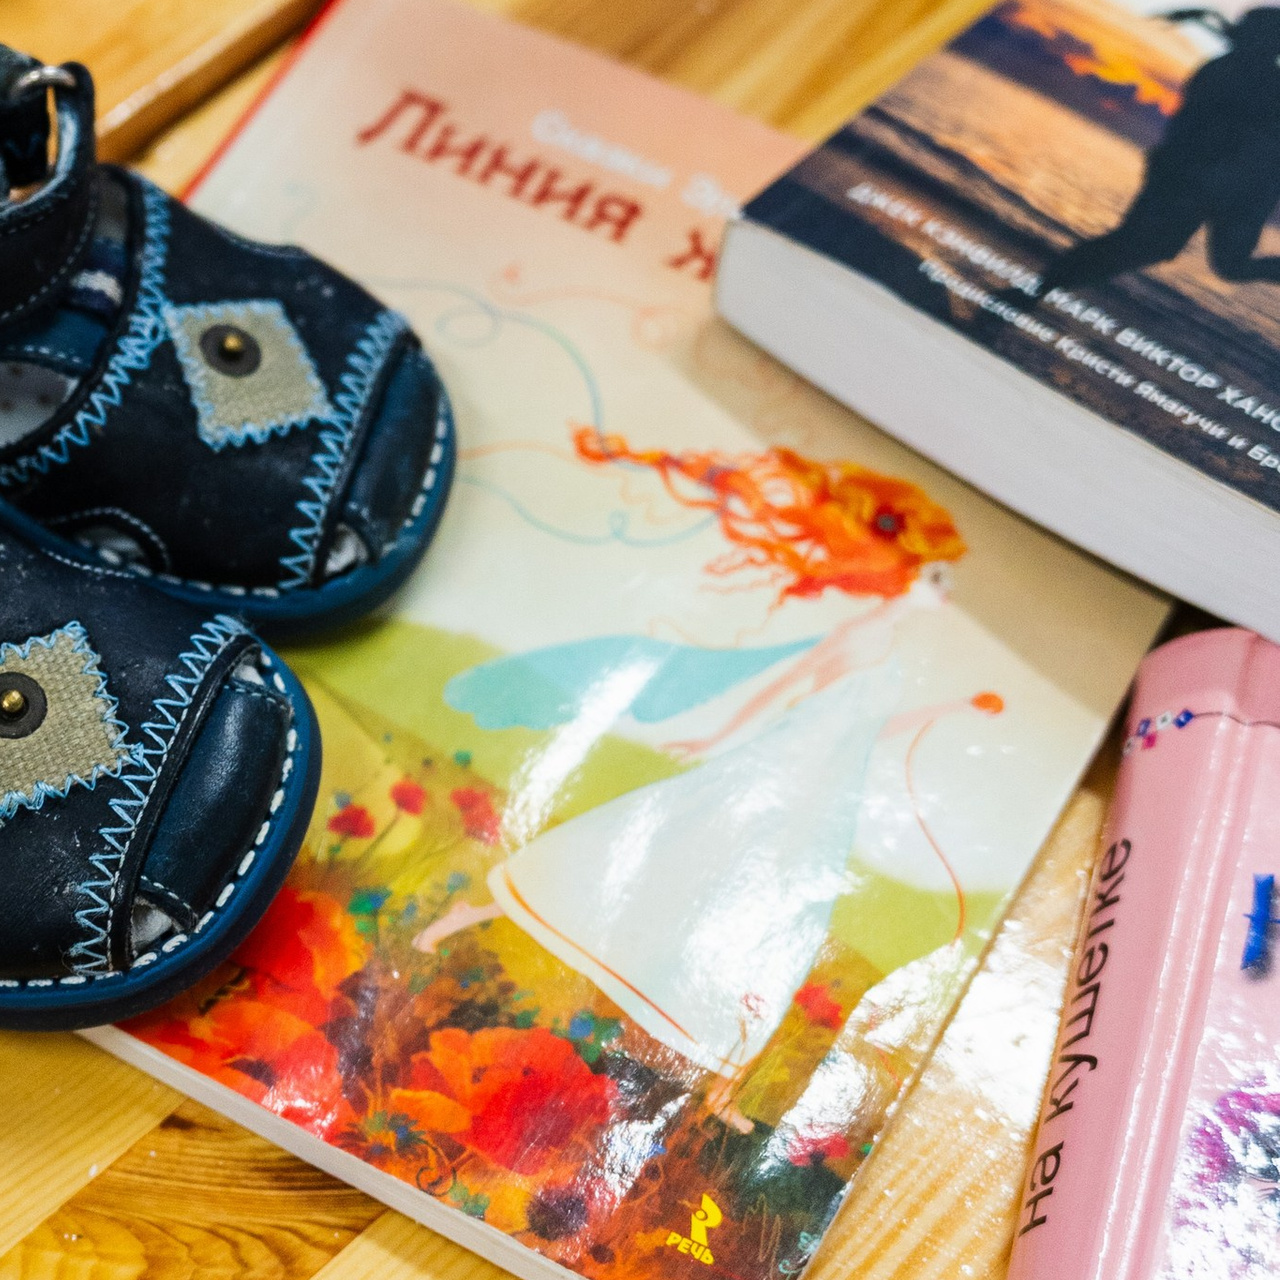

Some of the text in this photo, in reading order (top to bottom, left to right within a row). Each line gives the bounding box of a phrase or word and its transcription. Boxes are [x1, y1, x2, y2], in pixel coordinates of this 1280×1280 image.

[357, 87, 644, 243] Линия
[1043, 287, 1117, 336] МАРК
[1115, 327, 1222, 389] ВИКТОР
[1055, 335, 1136, 388] Кристи
[1133, 380, 1230, 440] Ямагучи
[1227, 434, 1249, 451] и
[1247, 443, 1280, 475] Бр
[1018, 837, 1133, 1238] на кушетке
[666, 1230, 715, 1265] РЕЧЬ
